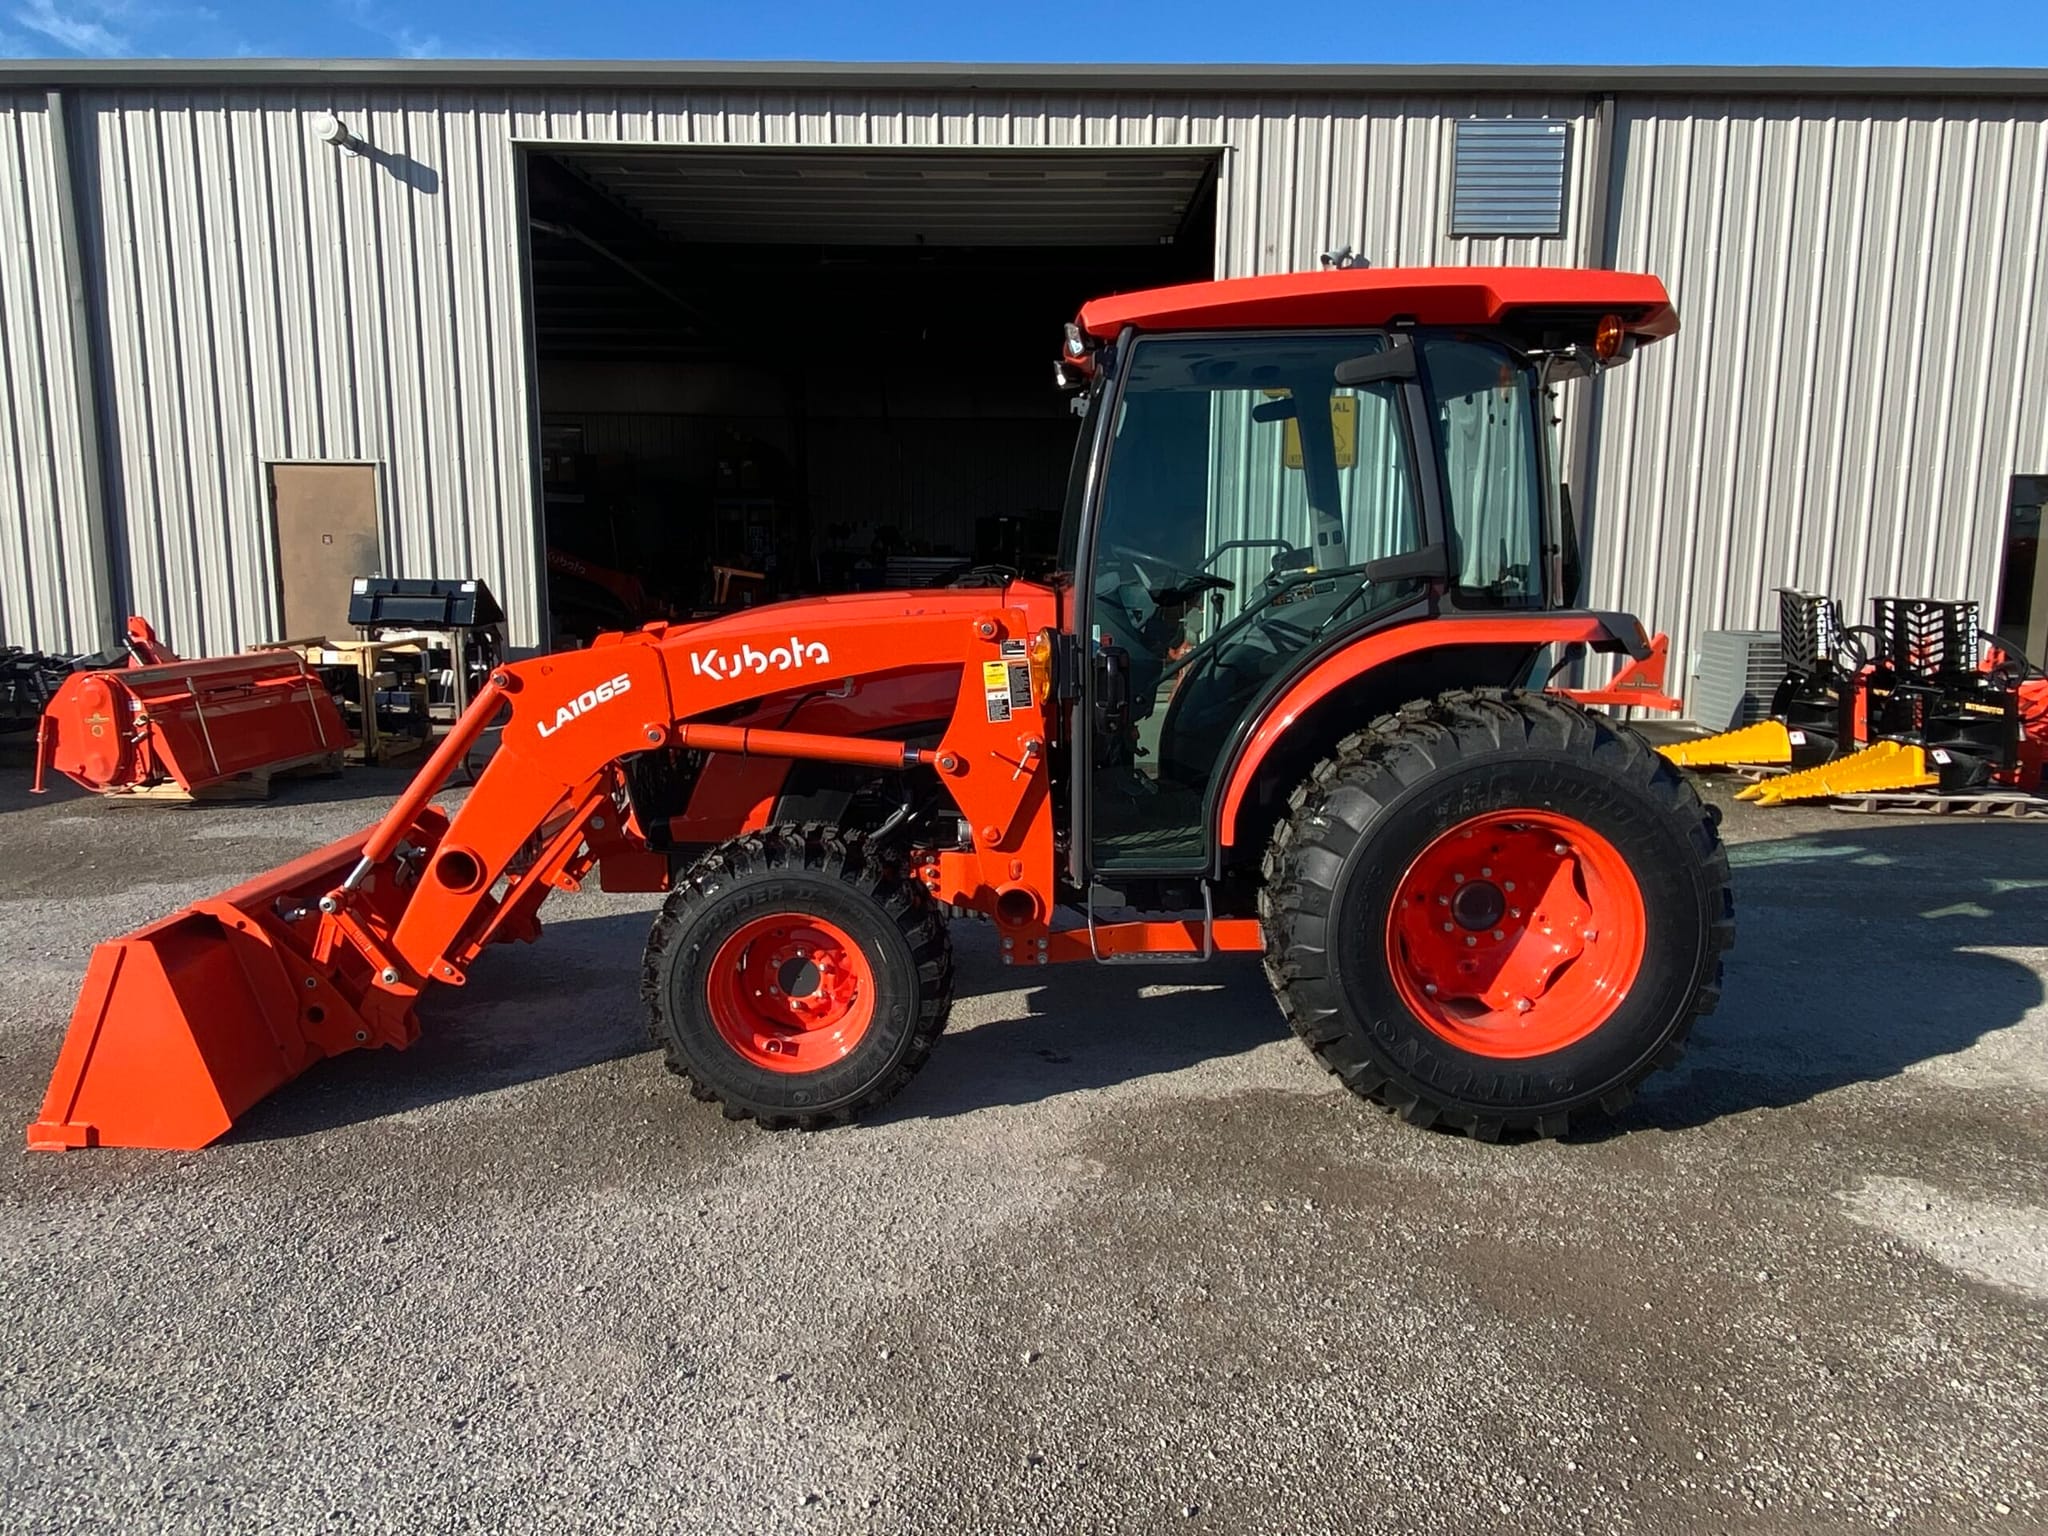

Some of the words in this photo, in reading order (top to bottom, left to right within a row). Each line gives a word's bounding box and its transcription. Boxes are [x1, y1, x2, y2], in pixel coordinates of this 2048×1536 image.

[690, 636, 830, 681] Kubota
[1817, 607, 1827, 657] DANUSER
[1968, 615, 1978, 671] DANUSER
[537, 673, 632, 738] LA1065
